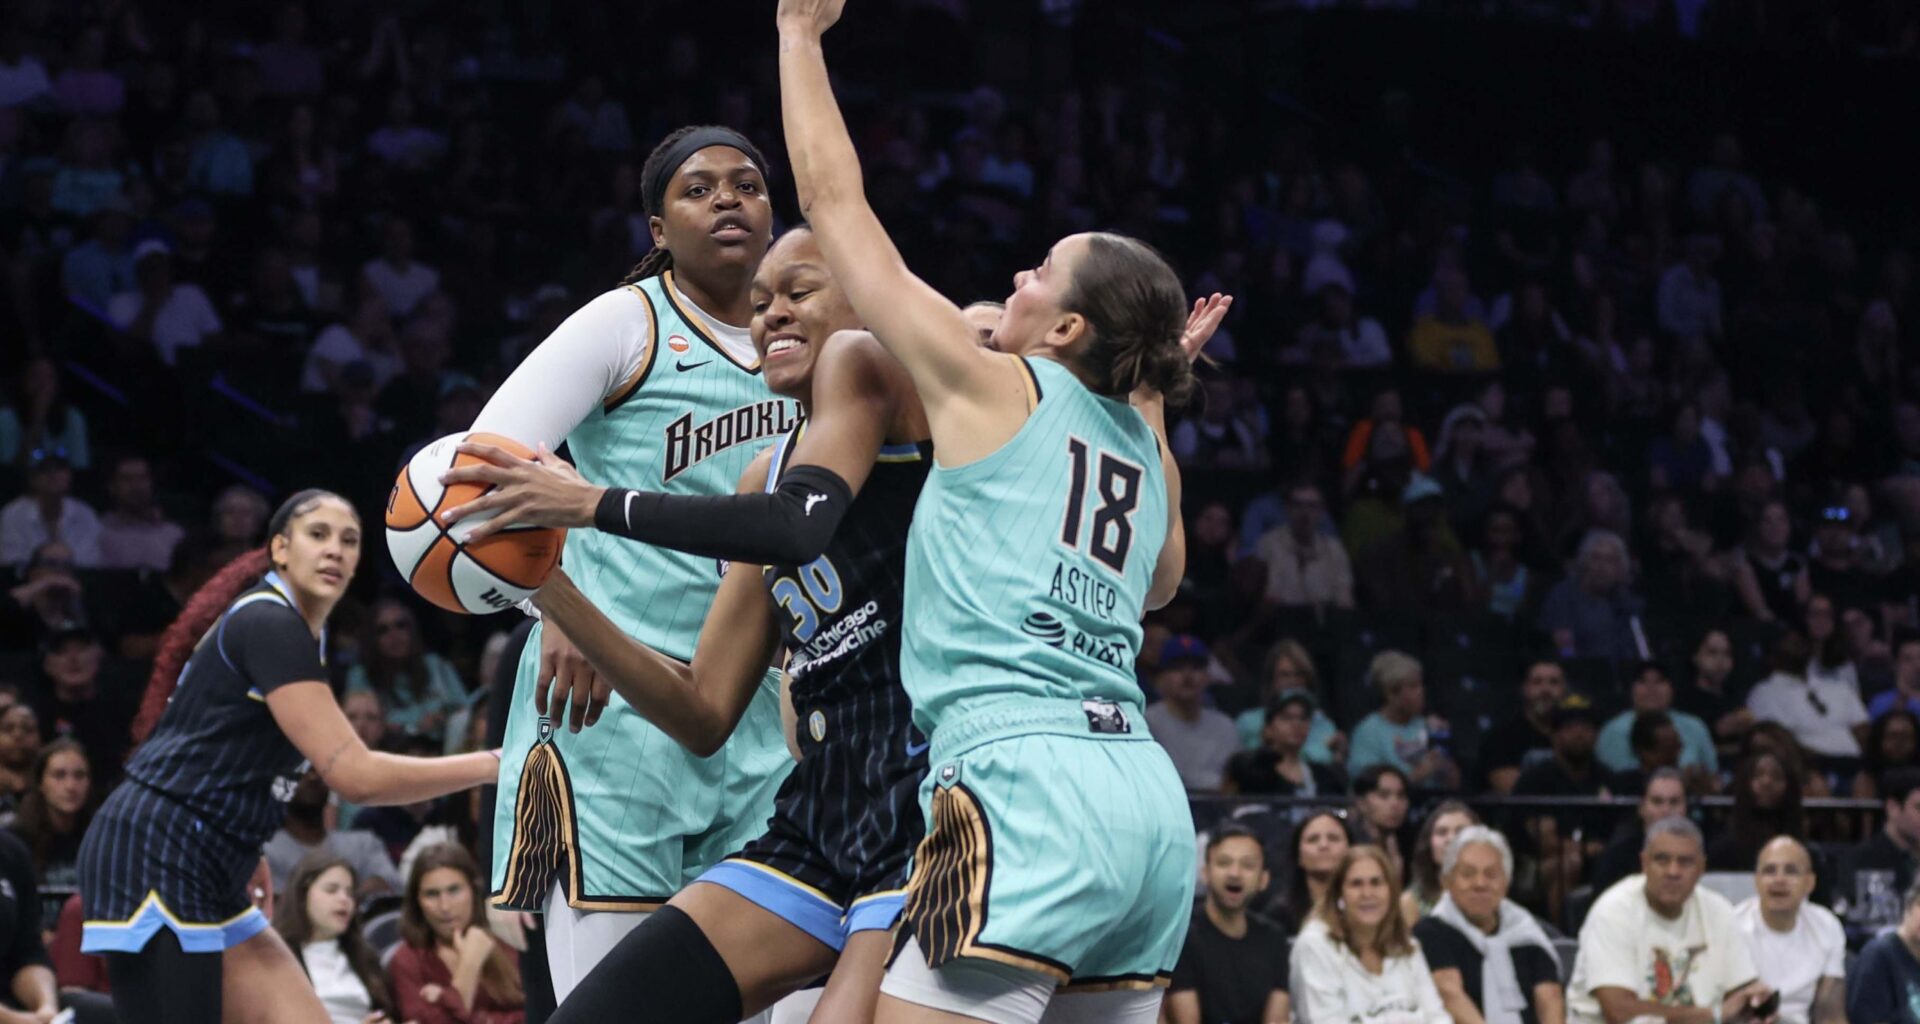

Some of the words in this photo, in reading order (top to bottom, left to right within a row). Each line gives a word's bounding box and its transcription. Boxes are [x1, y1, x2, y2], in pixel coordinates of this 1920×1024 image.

[1059, 432, 1145, 577] 18
[772, 553, 843, 644] 30
[805, 600, 878, 658] UChicago
[1049, 561, 1118, 624] ASTIER
